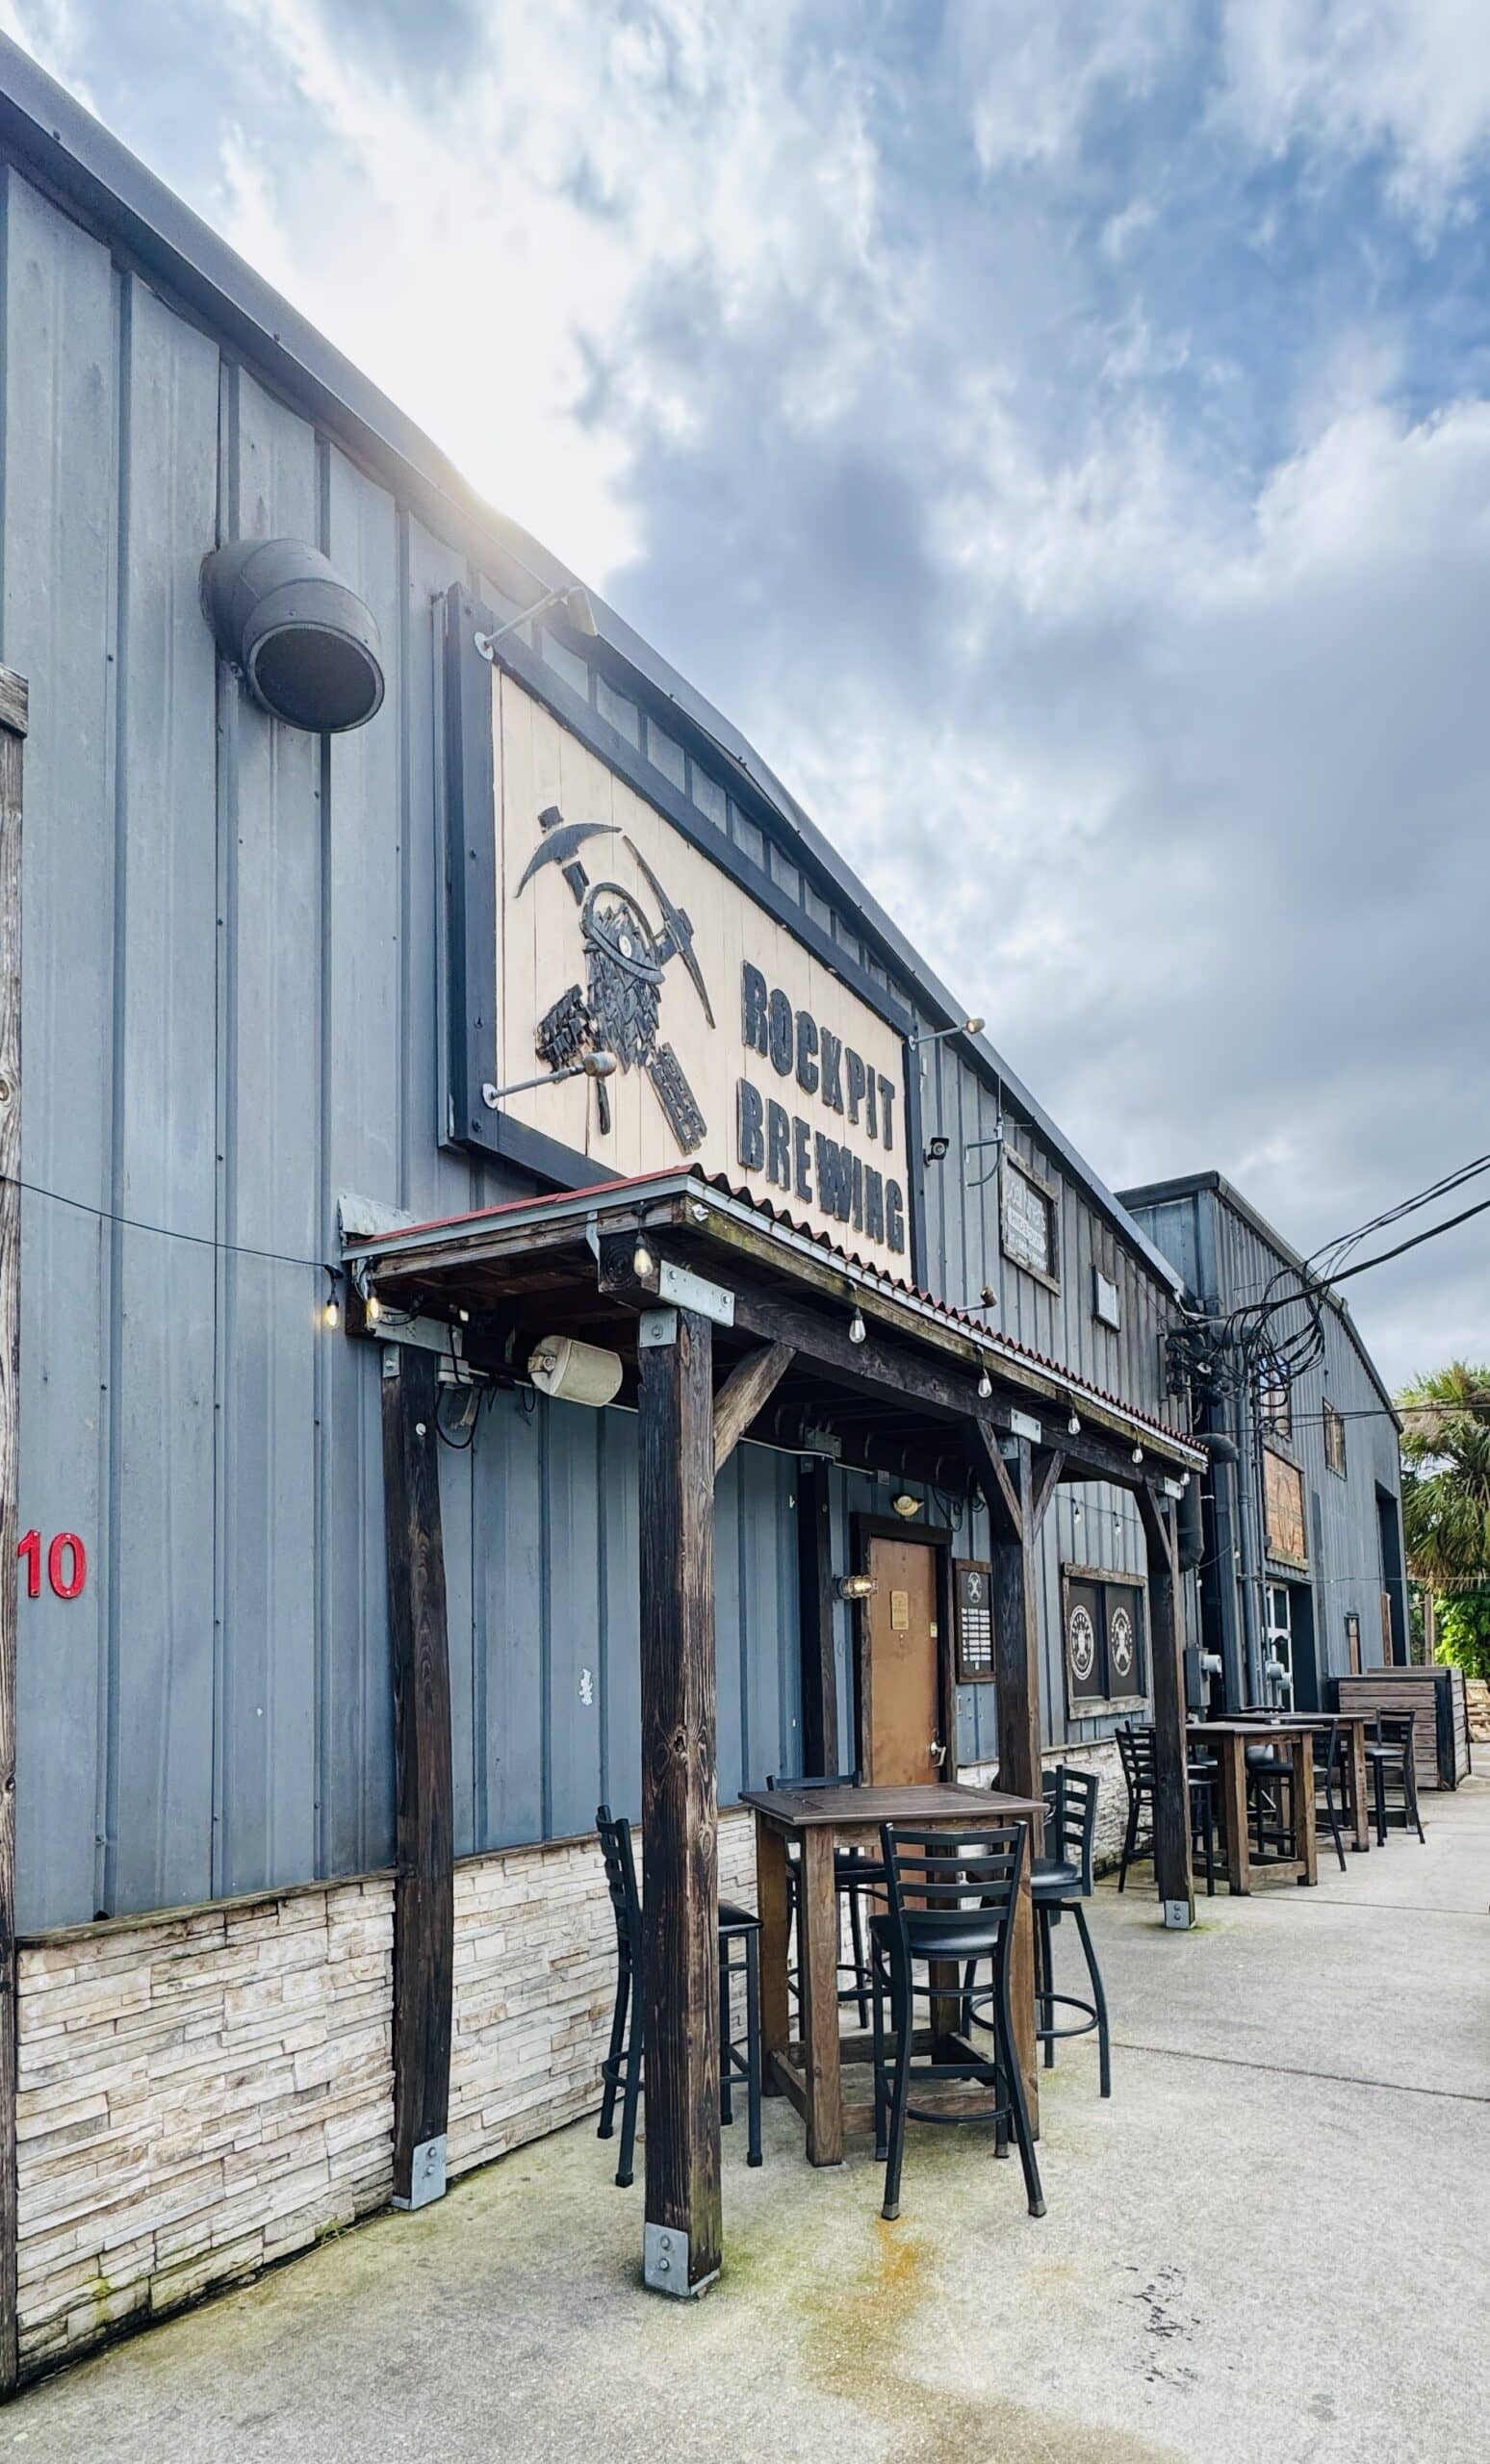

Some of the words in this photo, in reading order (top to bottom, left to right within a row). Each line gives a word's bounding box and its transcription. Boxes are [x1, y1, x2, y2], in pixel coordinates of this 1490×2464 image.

[741, 960, 895, 1150] ROCKPIT
[737, 1077, 905, 1255] BREWING
[17, 1529, 86, 1600] 10
